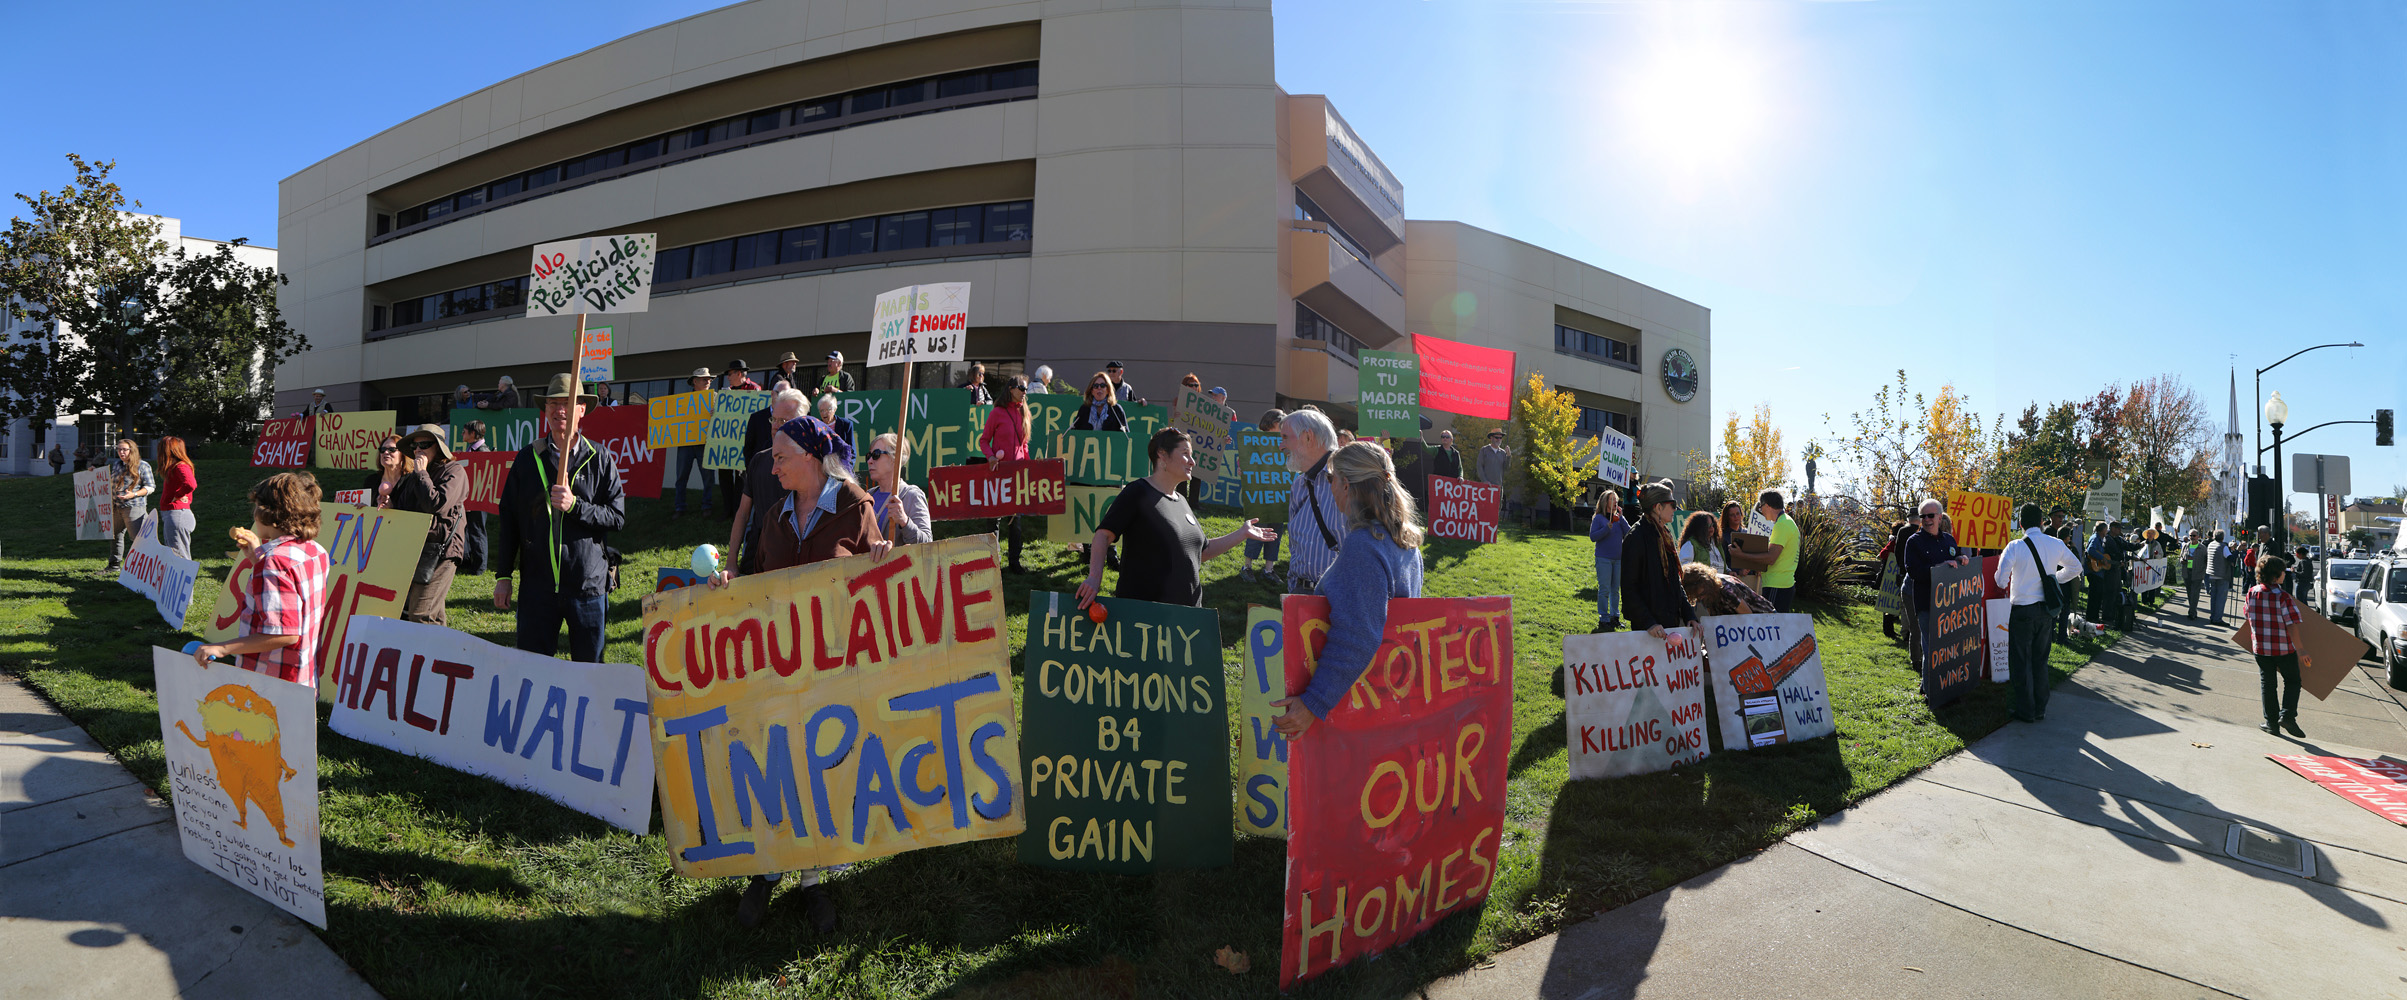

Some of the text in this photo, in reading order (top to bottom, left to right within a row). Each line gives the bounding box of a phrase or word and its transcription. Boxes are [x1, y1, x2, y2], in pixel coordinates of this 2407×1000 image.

[533, 238, 638, 314] Pesticide
[583, 264, 640, 312] Drift
[878, 312, 966, 340] SAY ENOUGH
[581, 345, 612, 360] hange
[879, 337, 917, 360] HEAR
[1363, 356, 1412, 369] PROTEGE
[1377, 373, 1397, 386] TU
[649, 392, 712, 420] CLEAN
[717, 392, 771, 413] PROTECT
[837, 398, 882, 424] RY
[1186, 392, 1229, 424] PEOPLE
[1362, 392, 1416, 405] MADRE
[1462, 396, 1473, 404] day
[1474, 397, 1483, 405] for
[266, 419, 307, 436] CRY IN
[321, 414, 342, 432] NO
[1182, 412, 1228, 439] STAND UP
[1367, 409, 1410, 420] TIERRA
[319, 427, 392, 451] CHAINSAW
[649, 418, 710, 446] WATER
[1605, 434, 1626, 451] NAPA
[254, 440, 307, 466] SHAME
[331, 452, 369, 470] WINE
[708, 444, 745, 466] NAPA
[1057, 433, 1141, 482] HALL
[1250, 452, 1288, 466] AGU
[1602, 450, 1629, 470] CLIMATE
[75, 481, 96, 498] KILLER
[930, 479, 961, 507] WE
[969, 477, 1012, 506] LIVE
[1435, 479, 1498, 503] PROTECT
[98, 503, 111, 515] TREES
[1441, 501, 1478, 520] NAPA
[98, 520, 111, 533] DEAD
[138, 519, 155, 539] NO
[1433, 519, 1498, 543] COUNTY
[1951, 519, 2010, 547] NAPA
[330, 513, 383, 573] IN
[2134, 565, 2152, 587] HALT
[1877, 595, 1900, 611] HILLS
[1935, 573, 1982, 608] CUT NAPA
[646, 554, 998, 692] CUMULATIVE
[1938, 603, 1980, 638] FORESTS
[1043, 612, 1200, 666] HEALTHY
[1716, 625, 1781, 648] BOYCOTT
[1932, 633, 1981, 670] DRINK HALL
[1570, 638, 1698, 696] KILLER HALL
[1666, 665, 1700, 694] WINE
[1736, 663, 1763, 687] CHAIN
[1939, 661, 1969, 690] WINES
[1039, 660, 1213, 714] COMMONS
[339, 643, 649, 786] HALT WALT
[1795, 706, 1823, 726] WALT
[1098, 715, 1141, 751] B4
[1581, 702, 1703, 755] KILLING NAPA
[1665, 728, 1701, 756] OAKS
[663, 672, 1012, 863] IMPACTS
[1031, 754, 1187, 804] PRIVATE
[1361, 724, 1486, 829] OUR
[177, 794, 218, 820] like you
[1049, 816, 1153, 862] GAIN
[184, 826, 215, 849] nothing
[219, 840, 228, 852] is
[233, 851, 257, 870] going
[262, 863, 271, 873] to
[273, 869, 288, 882] get
[225, 835, 250, 851] whole
[254, 847, 281, 864] awful
[288, 856, 307, 877] lot
[213, 852, 259, 886] IT'S
[1298, 828, 1493, 979] HOMES
